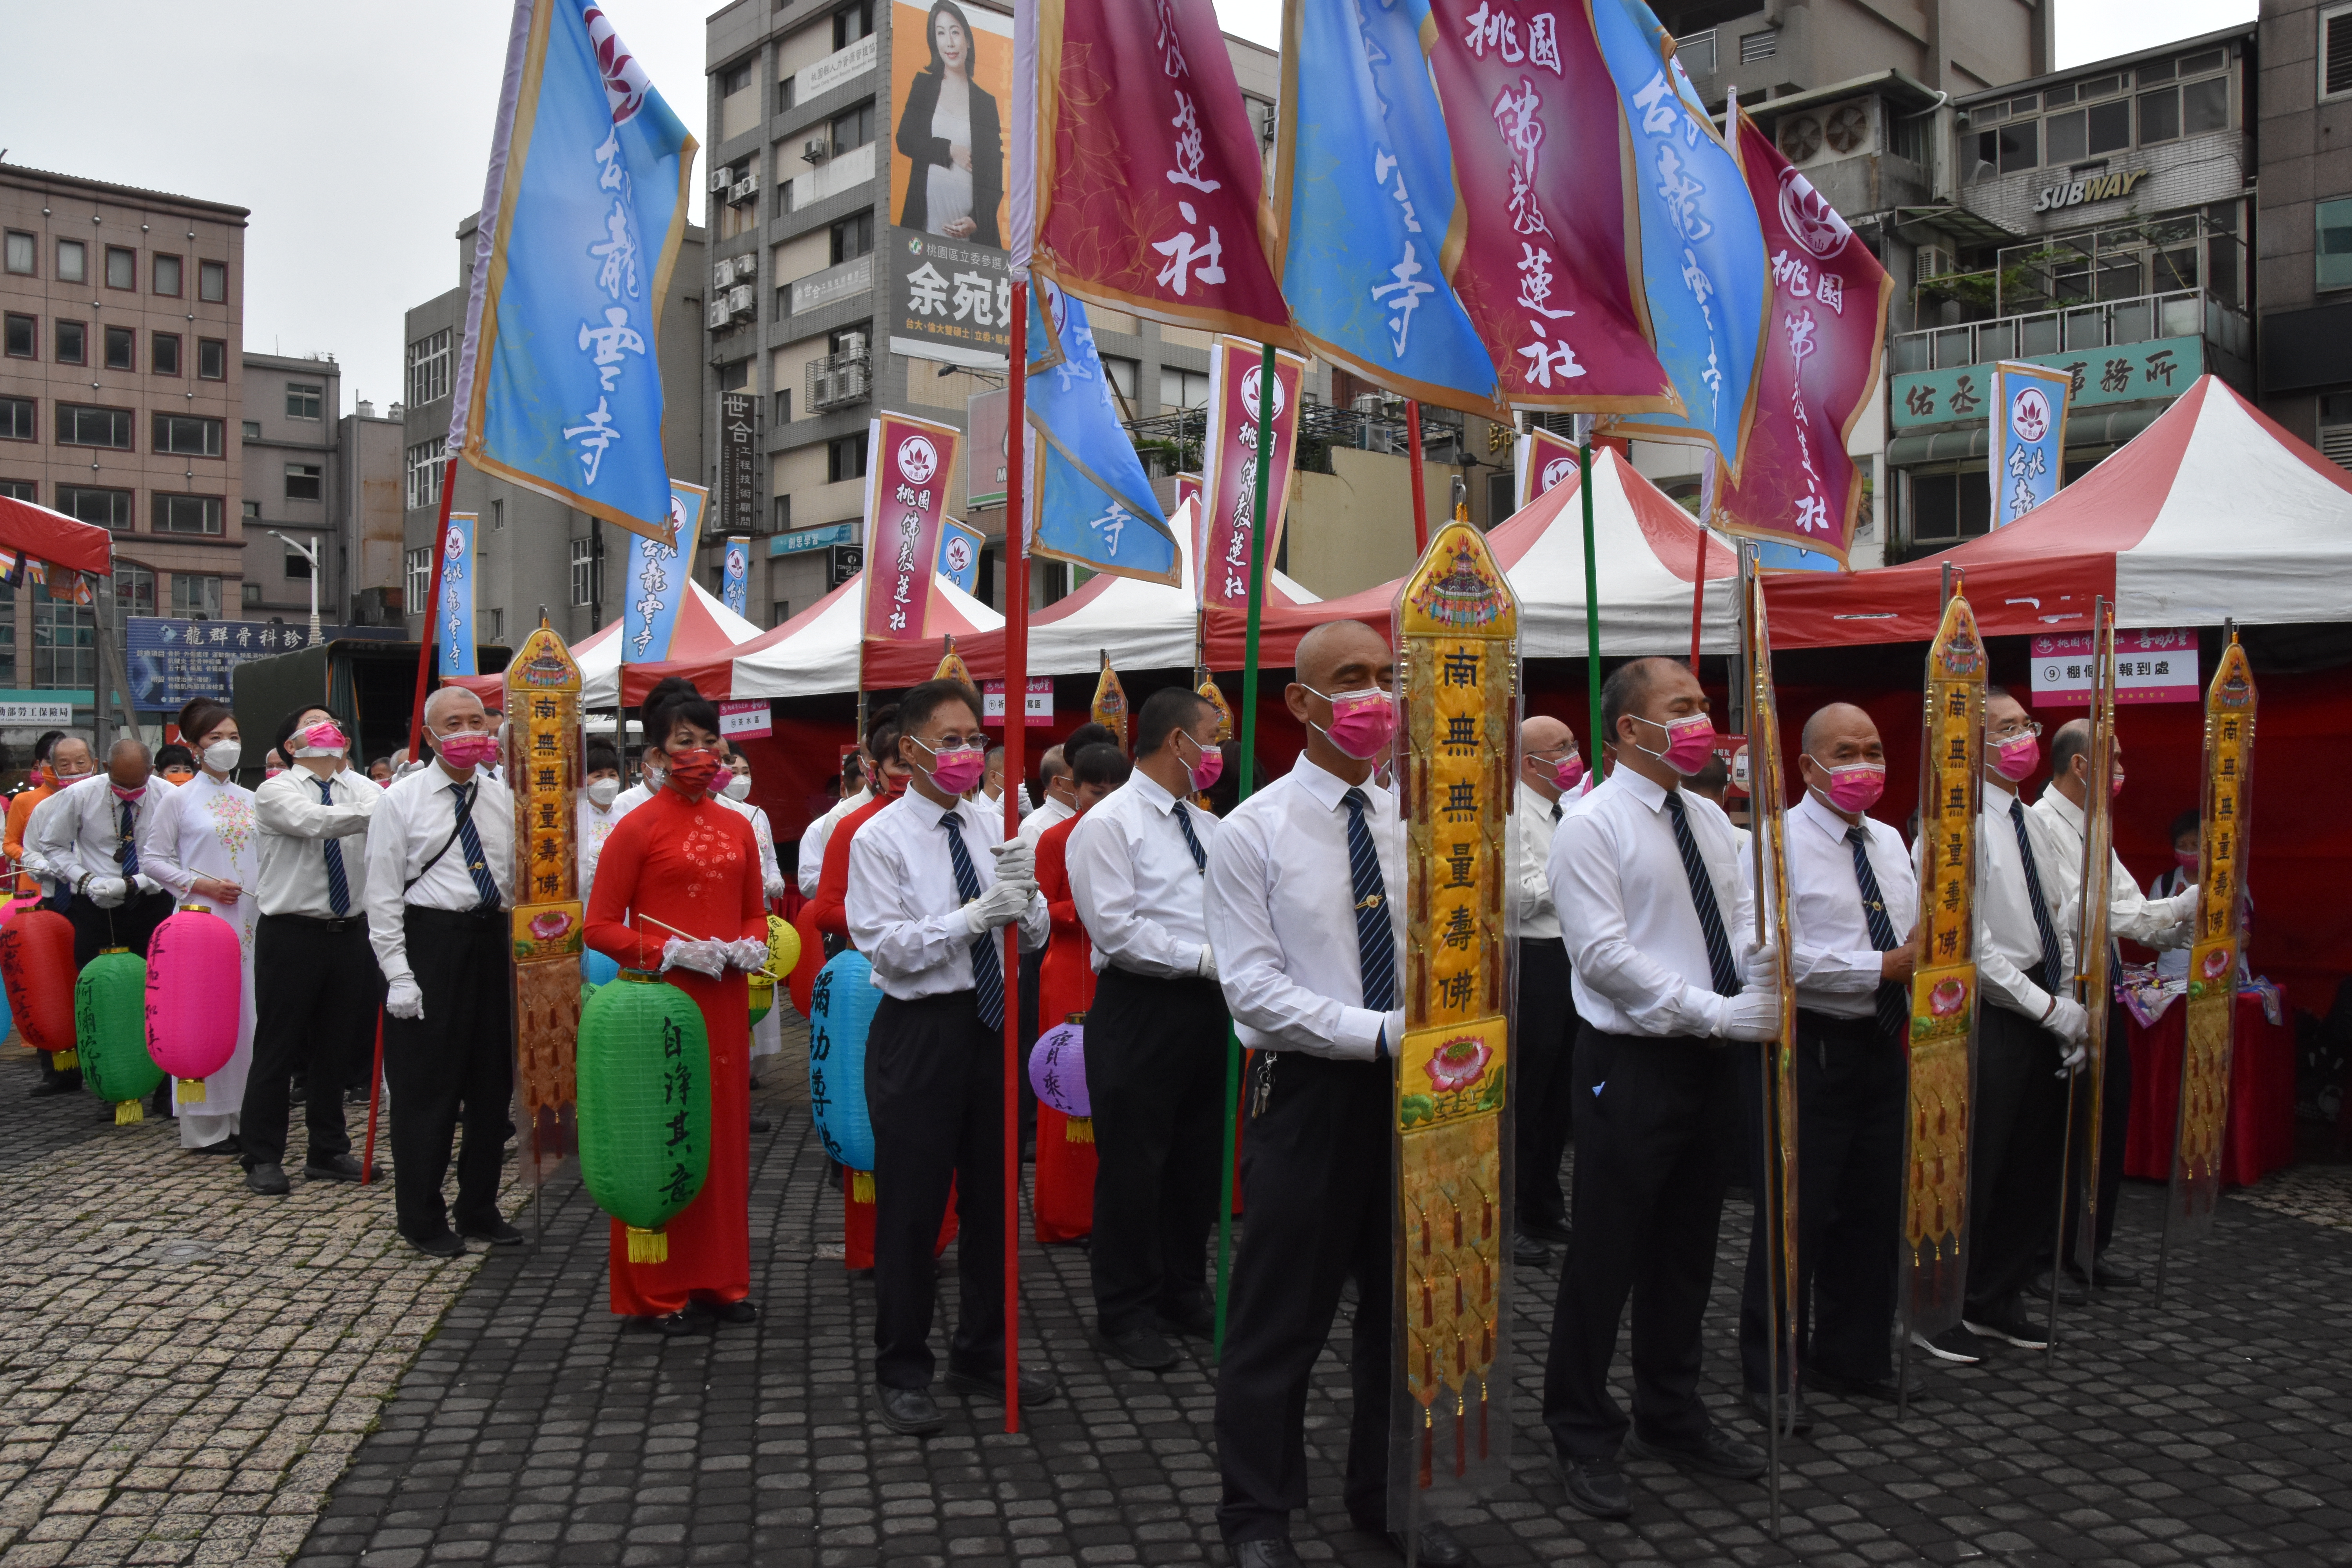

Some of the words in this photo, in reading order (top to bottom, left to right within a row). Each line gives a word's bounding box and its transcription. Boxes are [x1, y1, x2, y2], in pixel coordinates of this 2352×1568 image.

[2033, 169, 2149, 212] SUBWAY
[926, 243, 1011, 271] 桃園區立委參選人
[564, 125, 645, 485] 台龍雲寺
[1905, 350, 2178, 416] 佑丞事務所
[789, 534, 818, 549] 創思學習
[889, 483, 931, 631] 桃園佛教蓮社
[443, 562, 463, 669] 台北龍雲寺
[2057, 635, 2125, 651] 桃園佛社
[998, 700, 1041, 708] 祈寫區
[2066, 661, 2169, 679] 棚個報到處
[534, 696, 559, 897] 南無無量壽佛
[1438, 646, 1480, 1013] 南無無量壽佛
[1938, 688, 1967, 959] 南無無量壽佛
[2210, 719, 2238, 934] 南無無量壽佛
[658, 1016, 695, 1206] 自淨其意
[1043, 1030, 1074, 1110] 寶乘山
